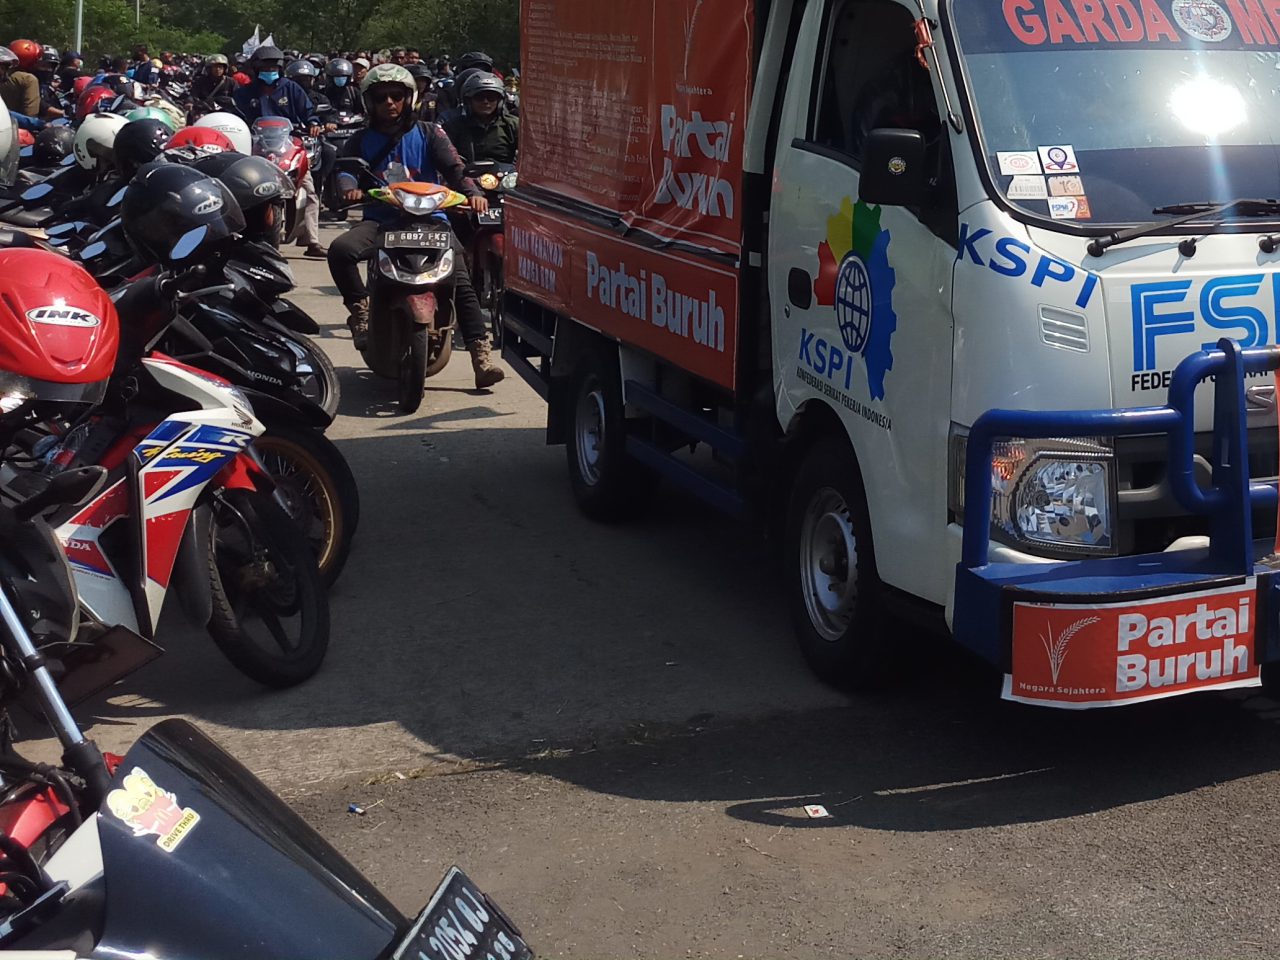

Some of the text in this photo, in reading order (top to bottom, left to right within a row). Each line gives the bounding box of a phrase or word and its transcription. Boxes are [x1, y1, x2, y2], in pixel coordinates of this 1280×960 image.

[661, 104, 736, 162] Partai
[955, 222, 1100, 309] KSPI
[35, 309, 91, 321] INK
[586, 250, 725, 352] Partai Buruh
[247, 370, 283, 385] HONDA
[798, 327, 853, 390] KSPI
[796, 365, 824, 392] KONFEDERASI
[841, 393, 861, 416] PEKERJA
[861, 405, 892, 431] INDONESIA
[1117, 597, 1250, 652] Partai
[1019, 681, 1107, 696] Negara Sejahtera
[1115, 638, 1249, 693] Buruh
[163, 812, 195, 848] DRIVE THRU
